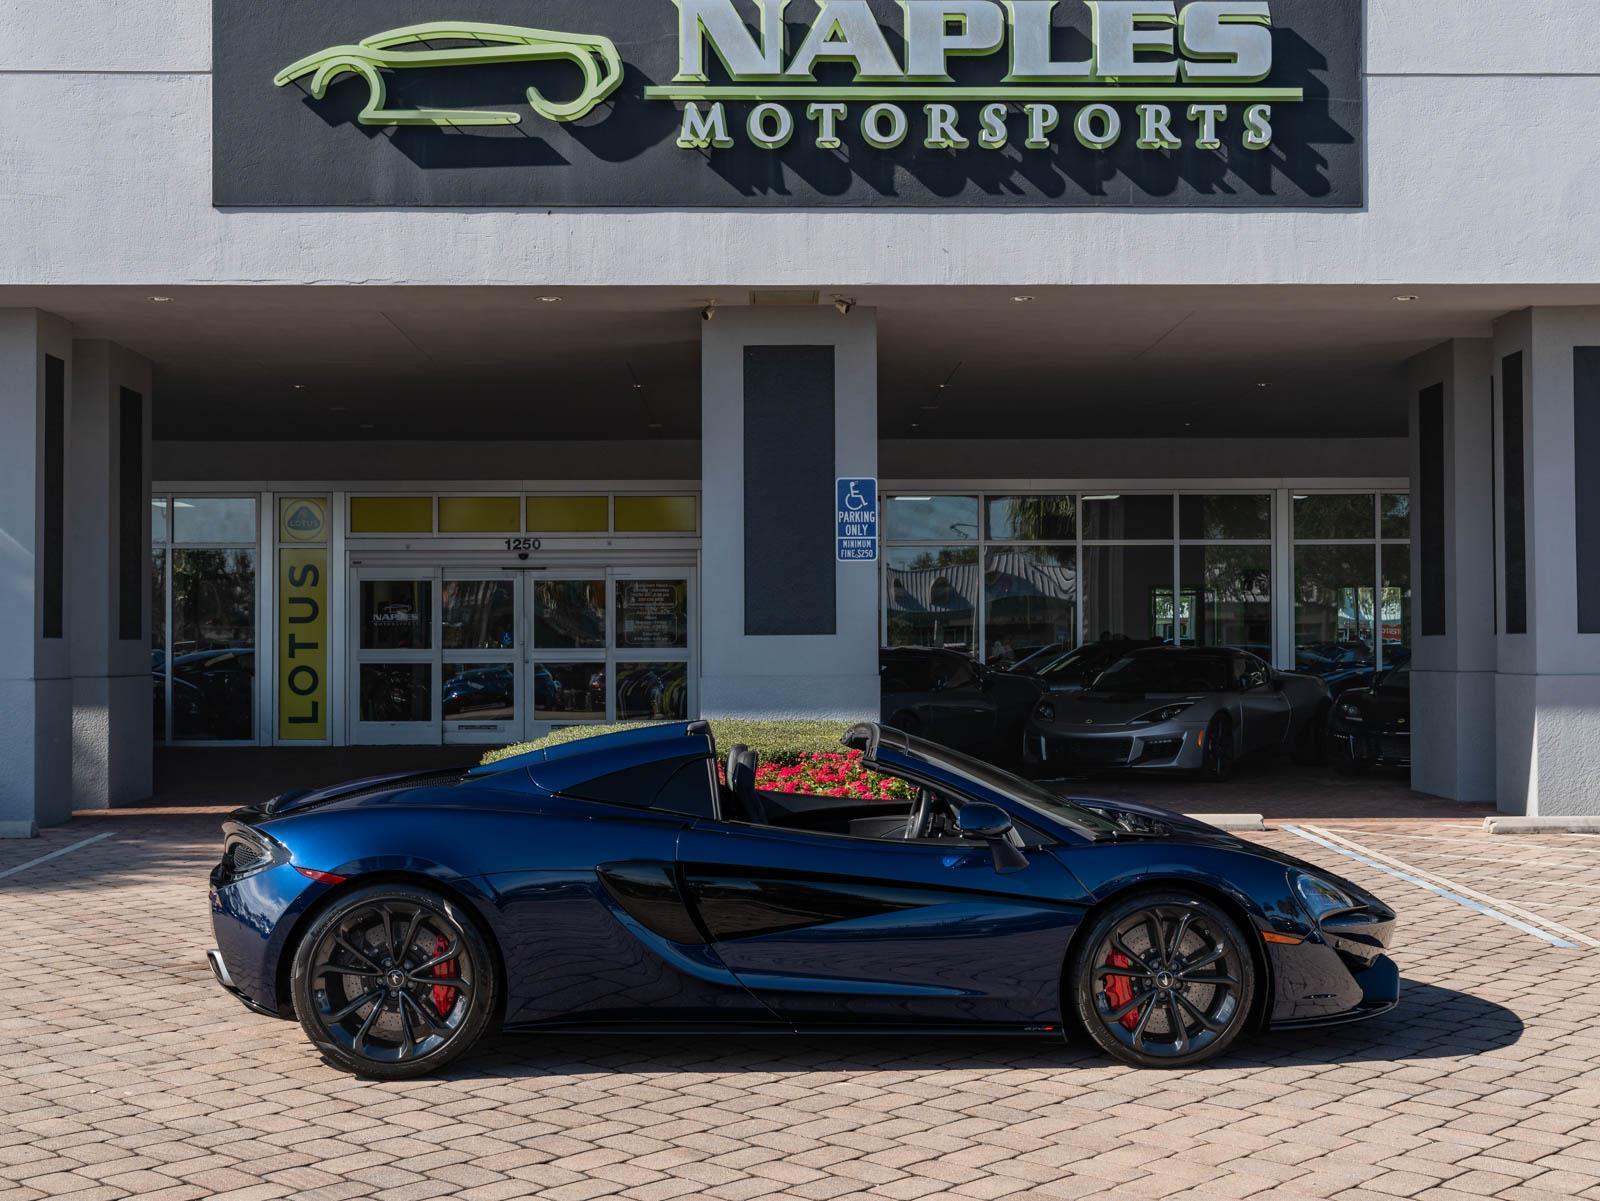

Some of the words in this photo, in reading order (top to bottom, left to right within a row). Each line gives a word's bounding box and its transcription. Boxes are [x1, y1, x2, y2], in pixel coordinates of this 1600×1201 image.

[672, 0, 1272, 82] NAPLES
[675, 101, 1272, 149] MOTORSPORTS
[839, 511, 875, 523] PARKING
[845, 524, 868, 536] ONLY
[504, 538, 541, 550] 1250
[842, 540, 872, 549] MINIMUM
[841, 549, 856, 558] FINE
[857, 549, 873, 558] $250
[288, 563, 319, 723] LOTUS
